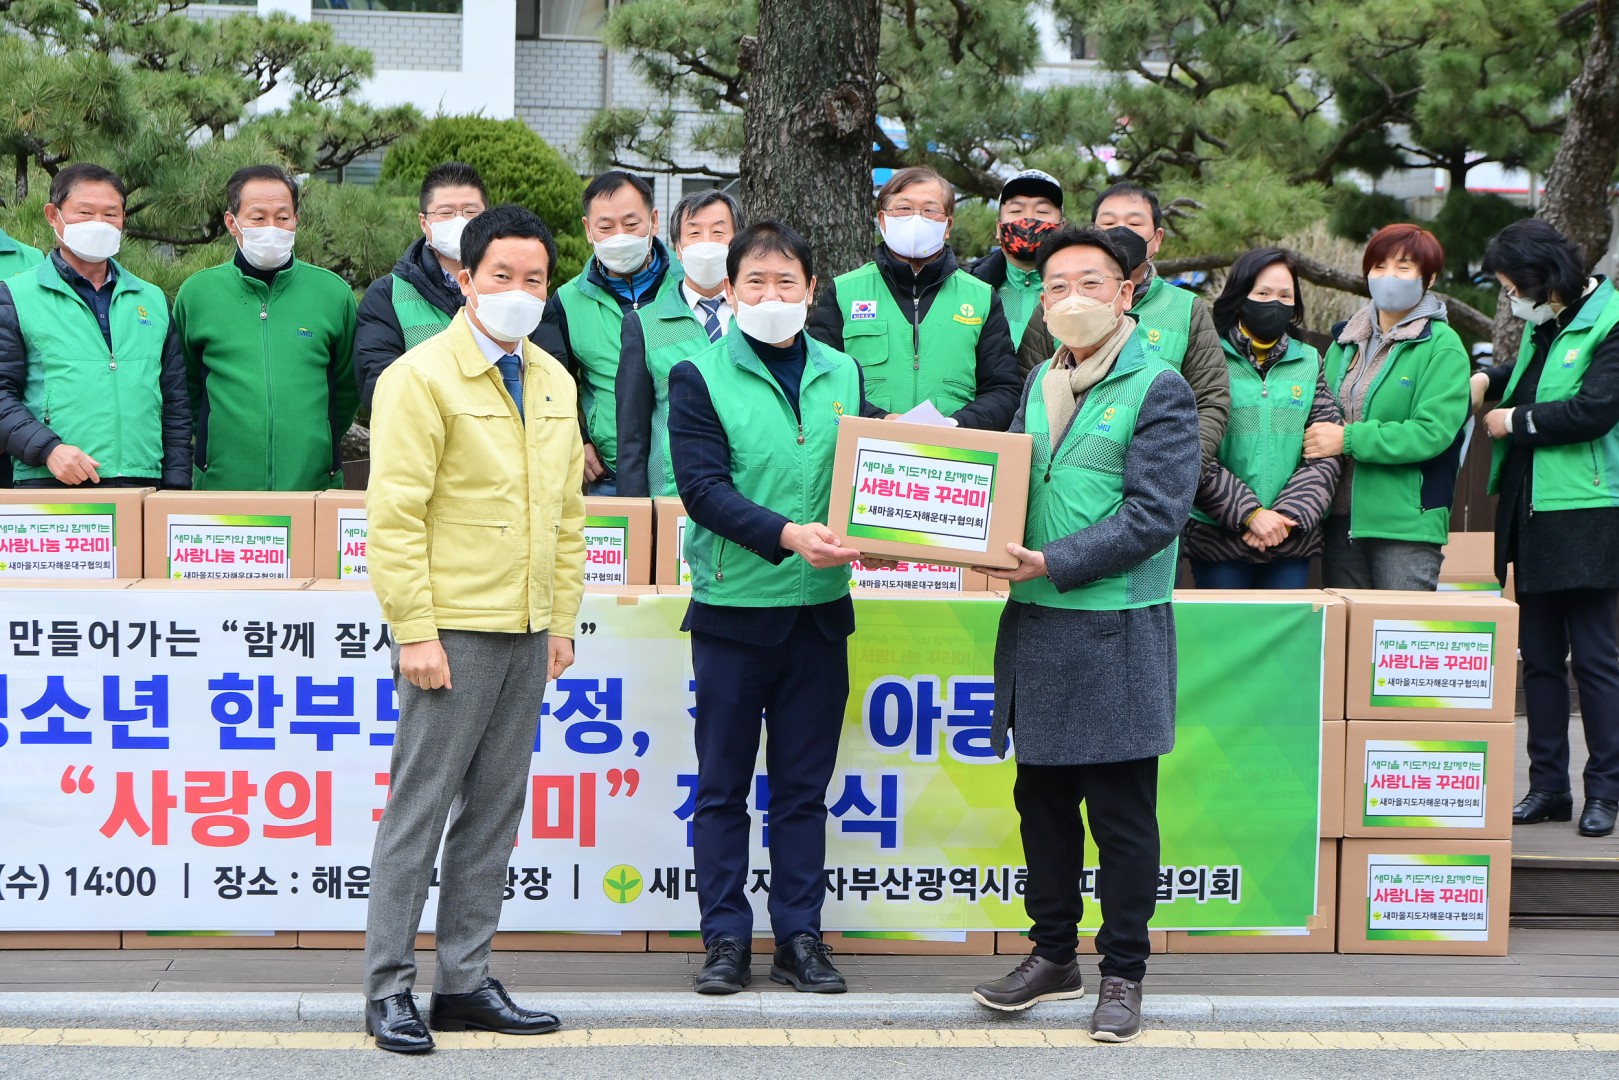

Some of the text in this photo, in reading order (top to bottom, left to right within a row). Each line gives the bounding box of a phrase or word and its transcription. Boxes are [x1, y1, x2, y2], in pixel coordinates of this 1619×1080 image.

[862, 461, 988, 486] 새마을 지도자와 함께하는
[859, 477, 986, 508] 사랑나눔 꾸러미
[868, 505, 983, 528] 새마을지도자해운대구협의회
[0, 523, 110, 534] 새마을 지도자와 함께하는
[0, 537, 110, 553] 사랑나눔 꾸러미
[174, 534, 285, 546] 새마을 지도자와 함께하는
[174, 548, 284, 565] 사랑나눔 꾸러미
[8, 561, 111, 571] 새마을지도자해운대구협의회
[858, 579, 957, 590] 새마을지도자해운대구협의회
[9, 619, 200, 658] 만들어가는
[1379, 640, 1489, 652] 새마을 지도자와 함께하는
[1378, 654, 1488, 671] 사랑나눔 꾸러미
[1387, 678, 1488, 689] 새마을지도자해운대구협의회
[1371, 760, 1482, 771] 새마을 지도자와 함께하는
[1370, 774, 1480, 790] 사랑나눔 꾸러미
[1379, 797, 1480, 808] 새마을지도자해운대구협의회
[64, 866, 157, 897] 14:00
[1374, 873, 1485, 885] 새마을 지도자와 함께하는
[1373, 888, 1484, 904] 사랑나눔 꾸러미
[1383, 911, 1484, 921] 새마을지도자해운대구협의회
